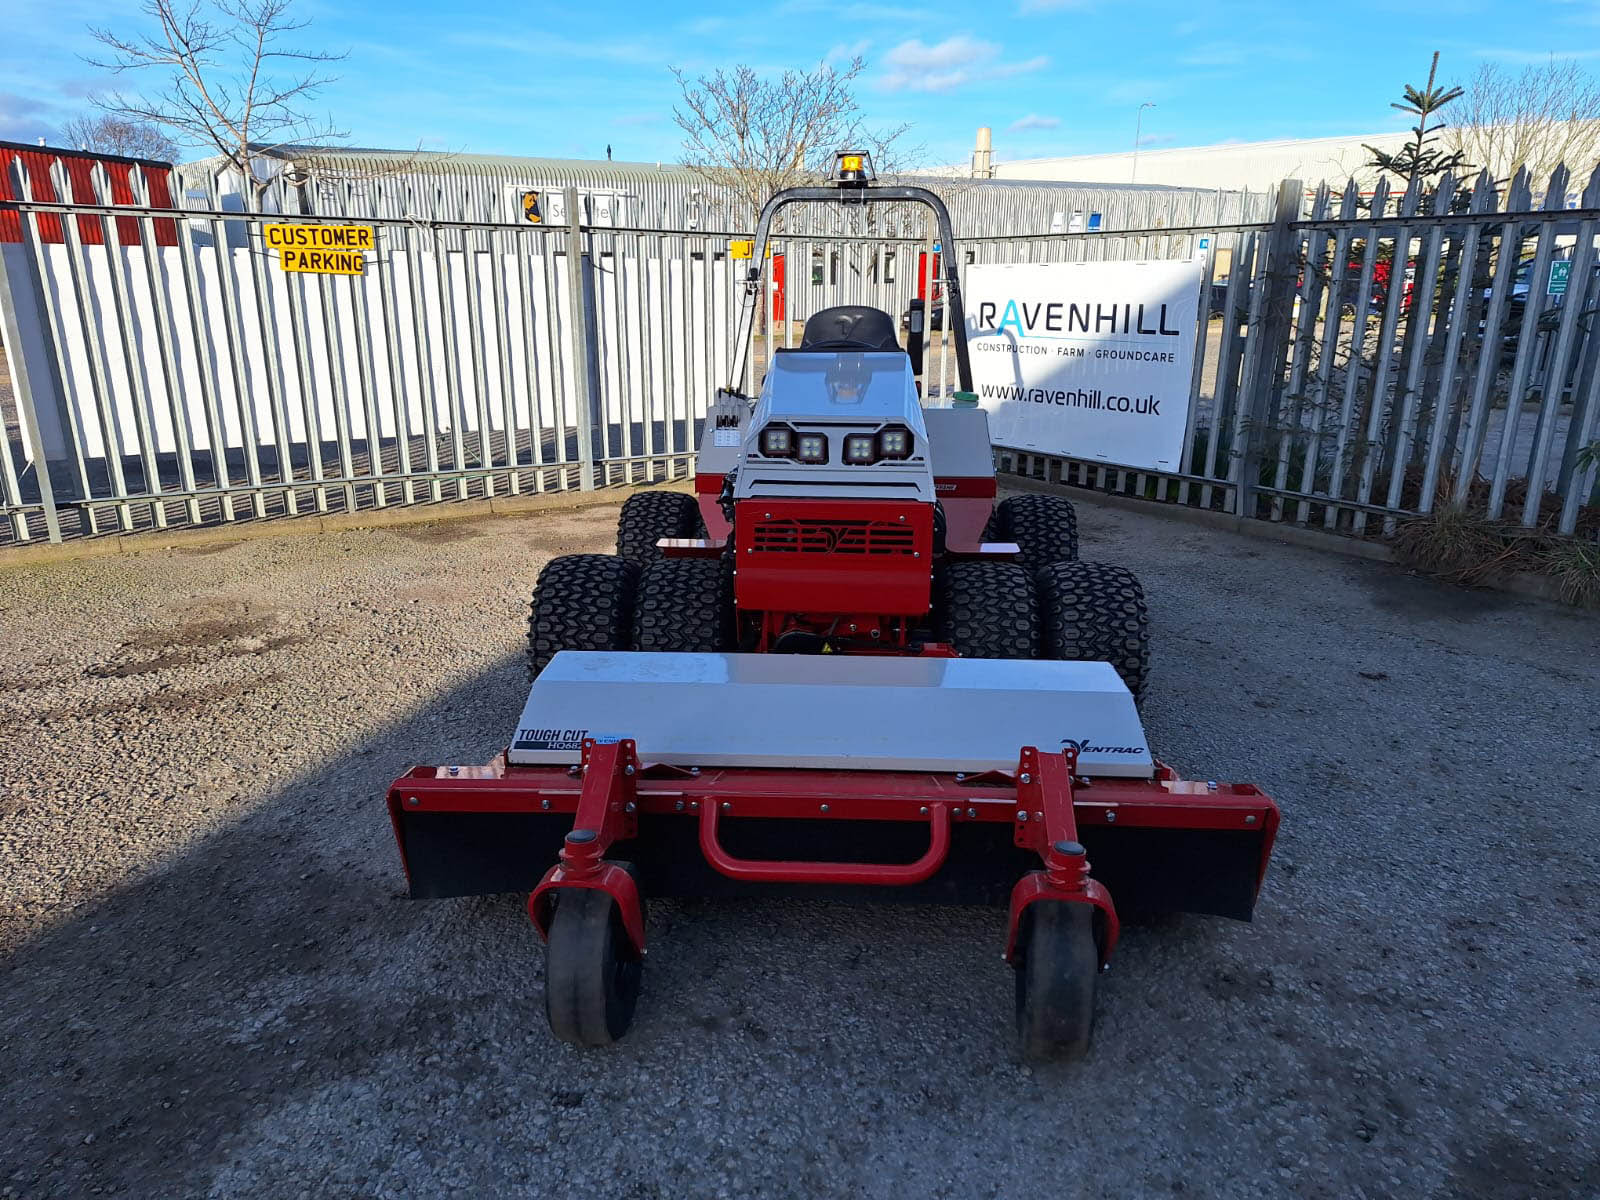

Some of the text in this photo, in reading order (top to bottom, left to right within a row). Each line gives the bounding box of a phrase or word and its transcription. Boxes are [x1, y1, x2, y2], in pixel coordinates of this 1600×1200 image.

[269, 227, 369, 246] CUSTOMER
[284, 250, 363, 272] PARKING
[979, 299, 1180, 336] RAVENHILL
[976, 341, 1175, 363] CONSTRUCTION FARM GROUNDCARE
[981, 383, 1161, 416] www.ravenhill.co.uk
[519, 728, 562, 741] TOUGH
[562, 729, 589, 741] CUT
